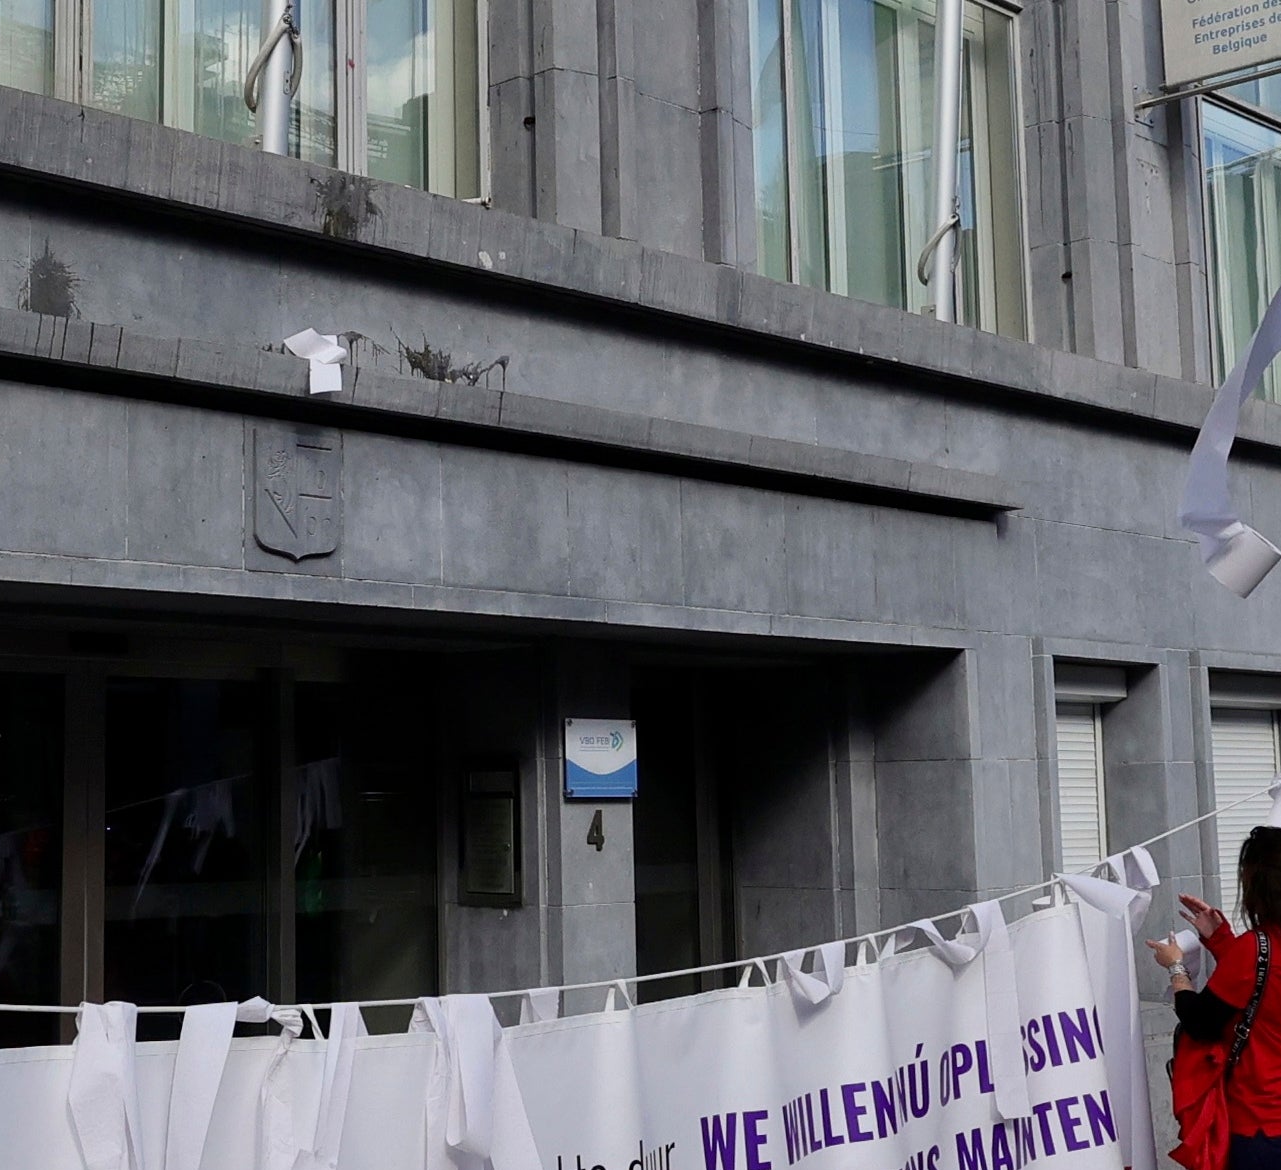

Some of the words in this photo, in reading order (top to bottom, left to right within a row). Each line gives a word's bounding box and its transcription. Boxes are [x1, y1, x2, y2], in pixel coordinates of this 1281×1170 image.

[1192, 3, 1259, 29] Fédération
[1194, 17, 1265, 44] Entreprises
[1212, 33, 1268, 55] Belgique
[586, 809, 605, 852] 4
[782, 1076, 898, 1166] WILLEN
[939, 1004, 1105, 1108] OPLSIN
